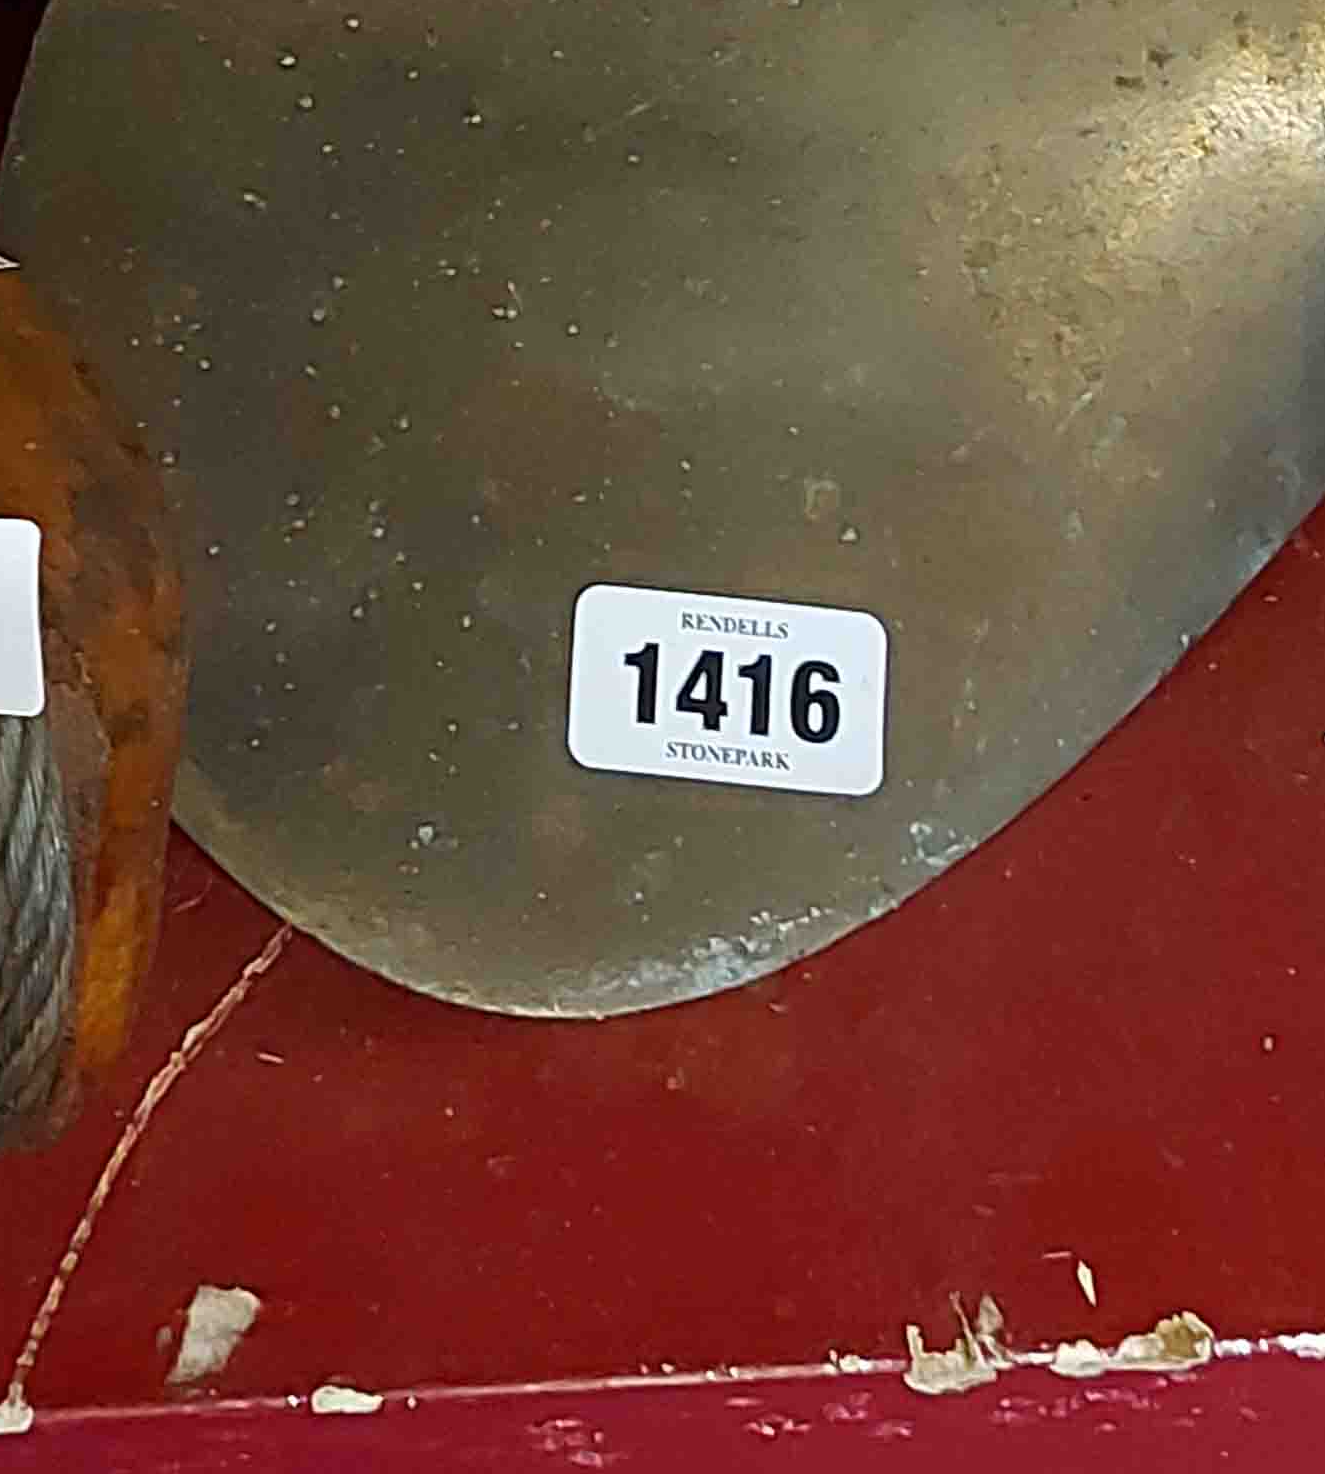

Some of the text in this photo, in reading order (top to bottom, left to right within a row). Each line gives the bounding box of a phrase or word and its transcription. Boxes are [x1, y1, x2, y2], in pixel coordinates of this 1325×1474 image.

[681, 613, 789, 640] RENDELLS
[625, 643, 841, 745] 1416
[665, 742, 791, 771] STONEPARK
